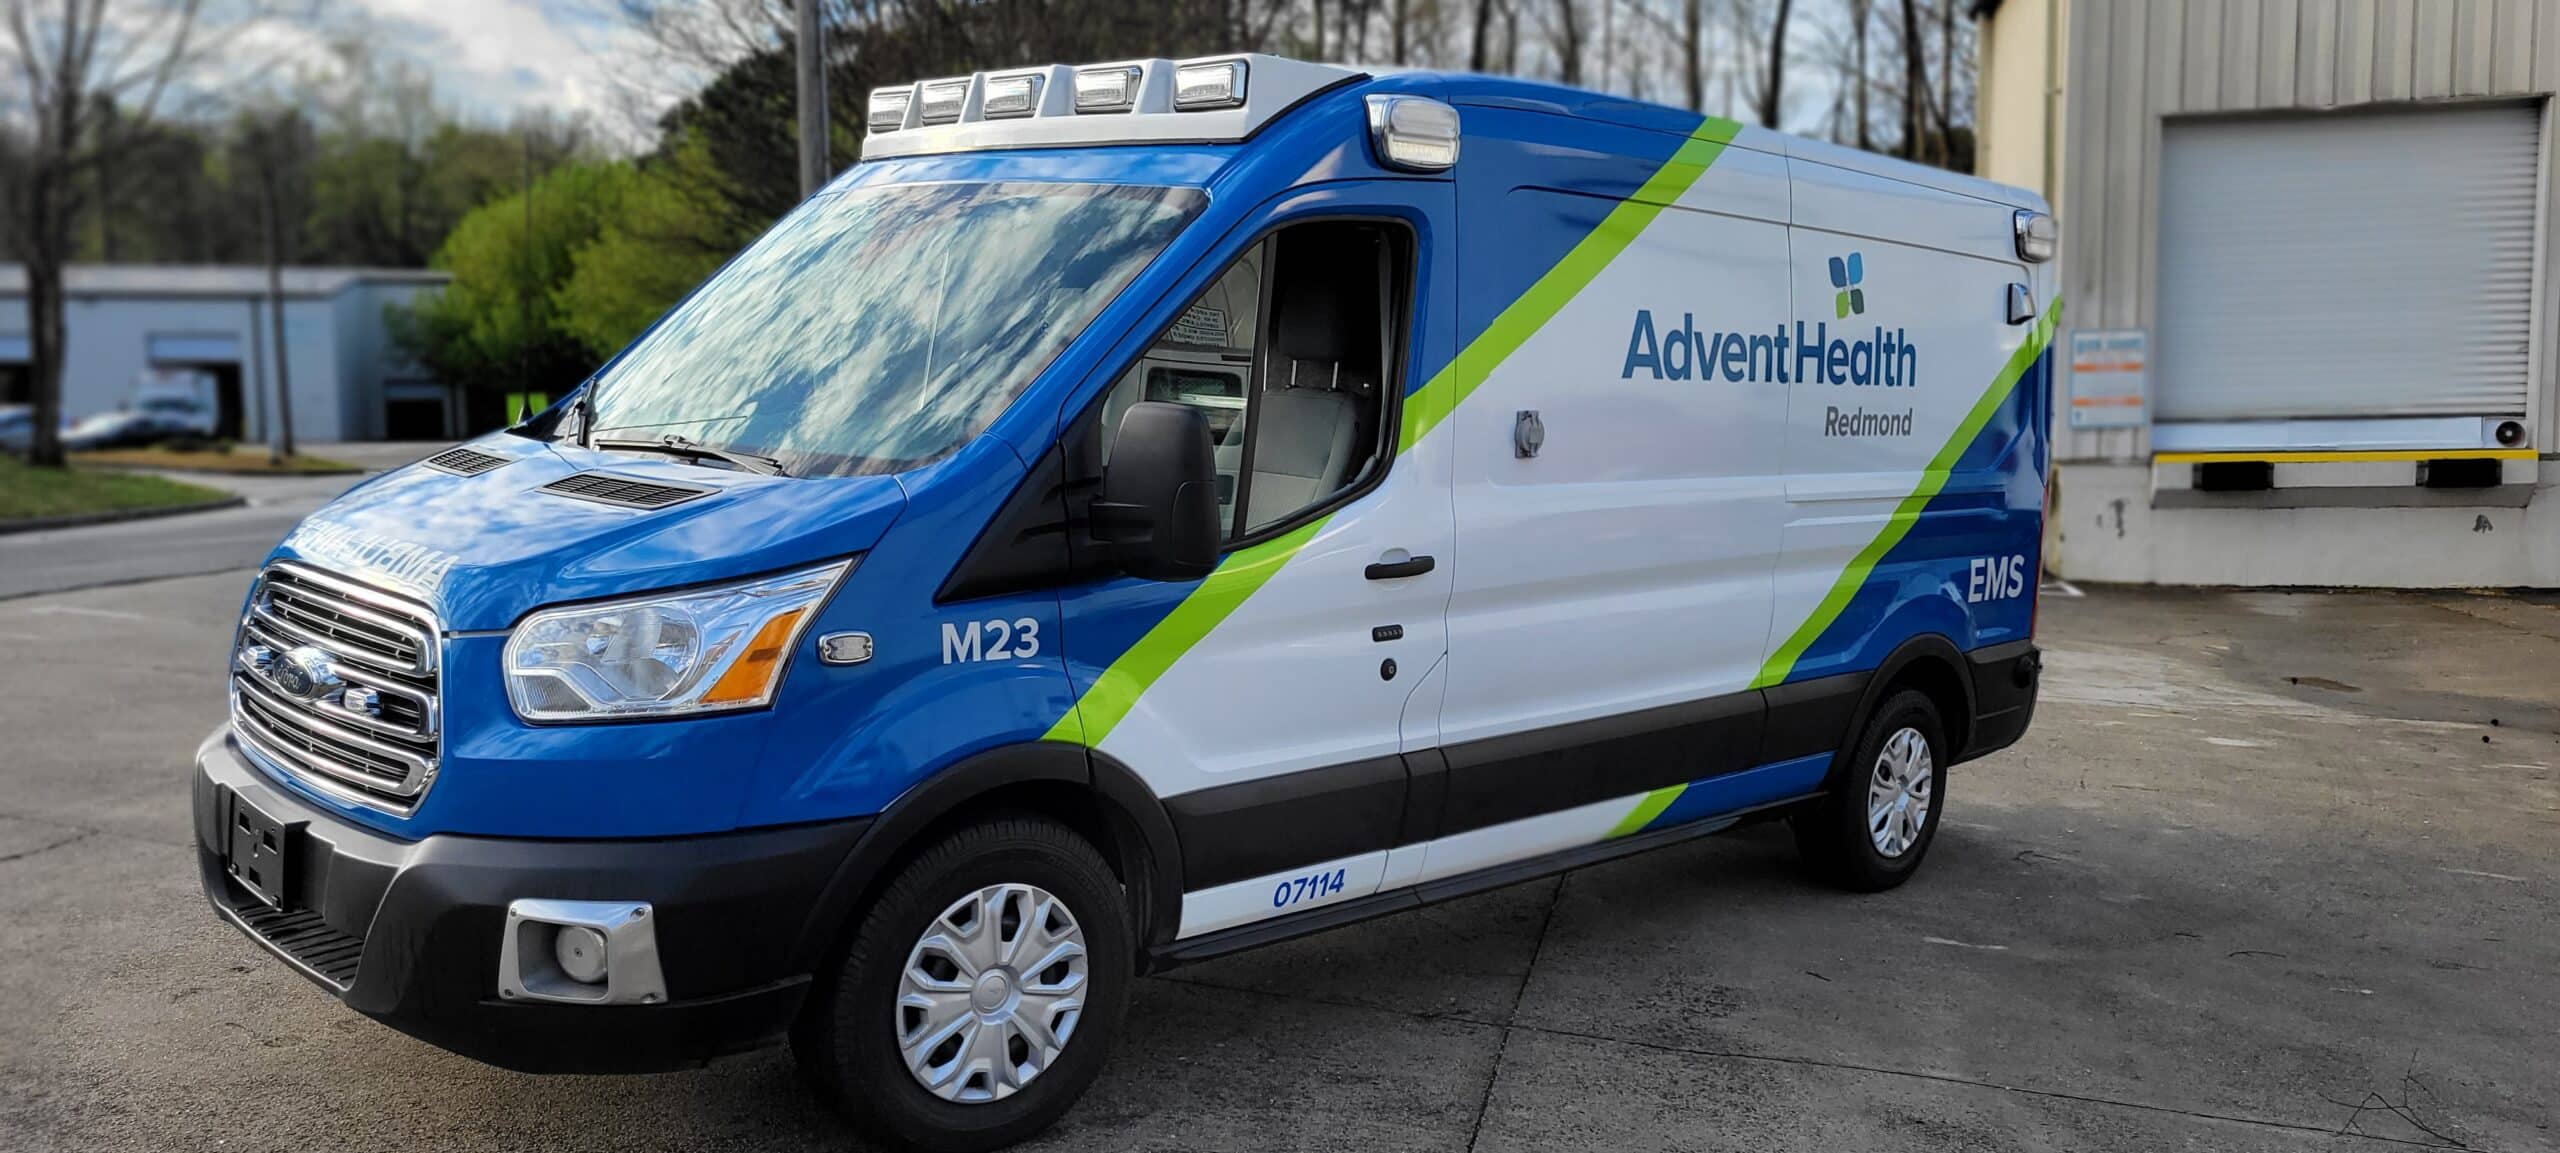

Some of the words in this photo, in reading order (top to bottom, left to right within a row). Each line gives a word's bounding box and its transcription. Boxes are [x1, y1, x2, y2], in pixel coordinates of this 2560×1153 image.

[1622, 309, 1917, 387] AdventHealth
[1824, 406, 1914, 438] Redmond
[1967, 554, 2025, 603] EMS
[941, 617, 1040, 665] M23
[1273, 867, 1346, 908] 07114
